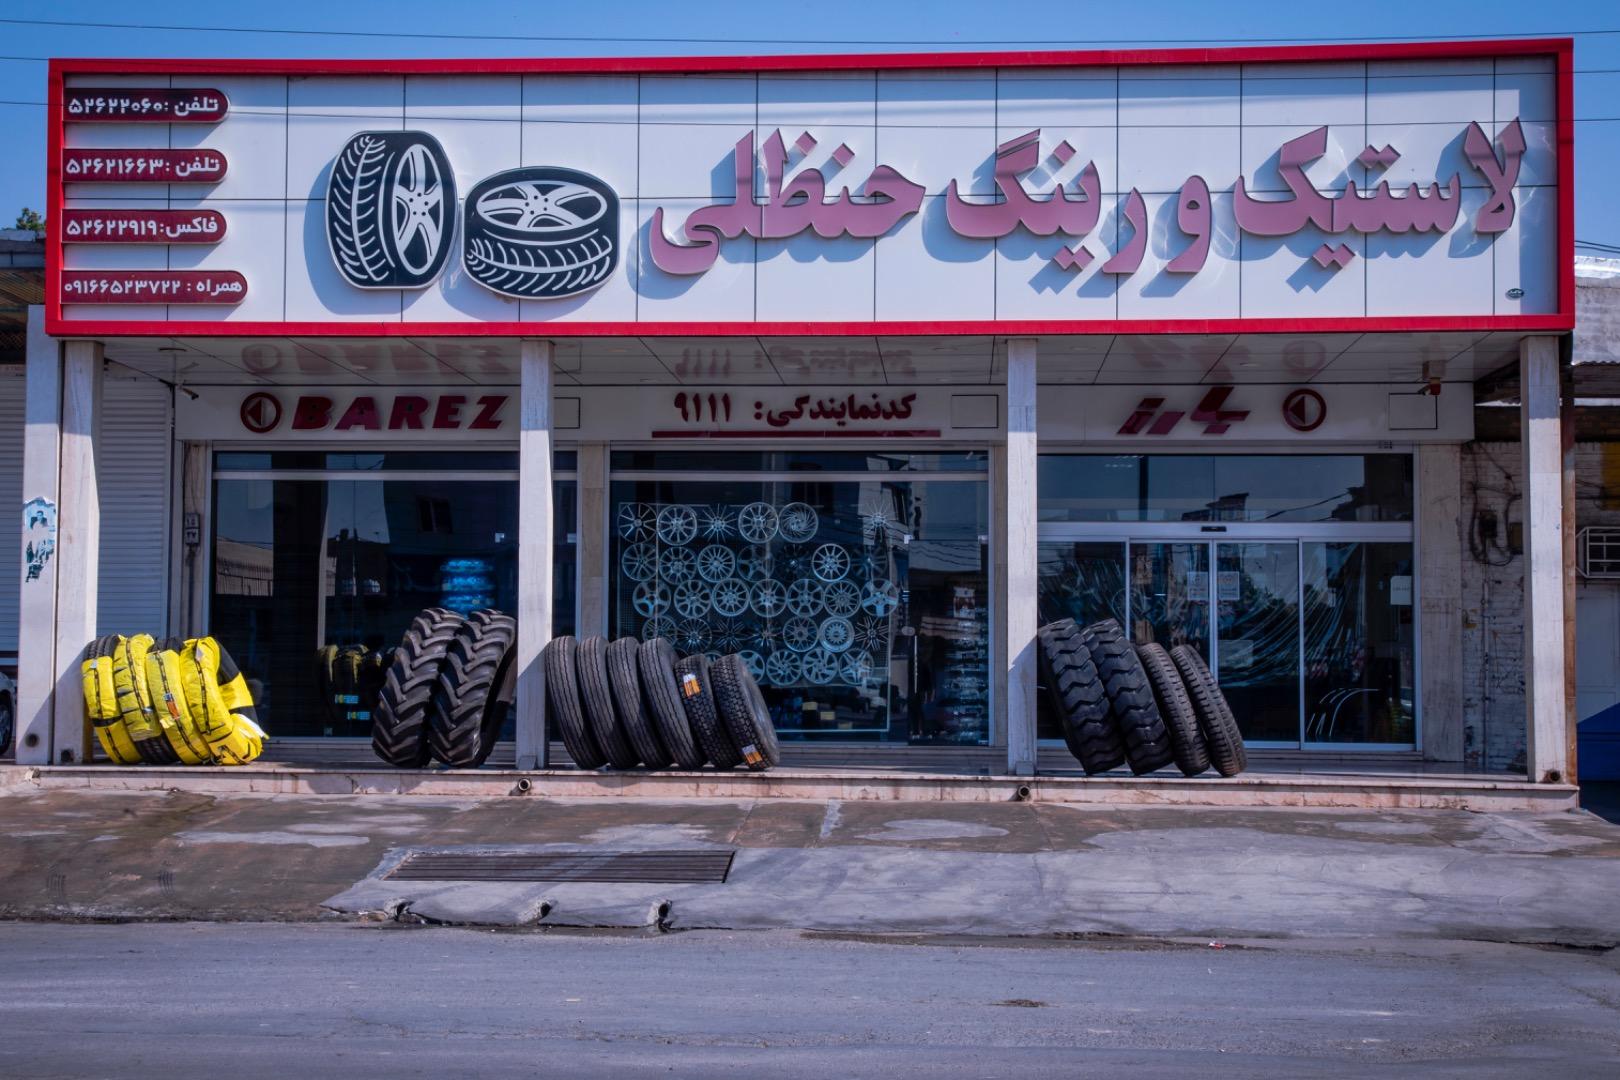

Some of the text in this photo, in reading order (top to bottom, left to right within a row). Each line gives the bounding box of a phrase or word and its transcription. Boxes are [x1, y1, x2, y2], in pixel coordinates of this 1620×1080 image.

[66, 157, 164, 175] ۵۲۶۲۱۶۶۳
[649, 127, 926, 275] حنظلی
[1232, 117, 1527, 269] لاستیک
[66, 218, 157, 236] ۵۲۶۲۲۹۱۹
[292, 395, 508, 431] BAREZ
[673, 391, 732, 423] ۹۱۱۱
